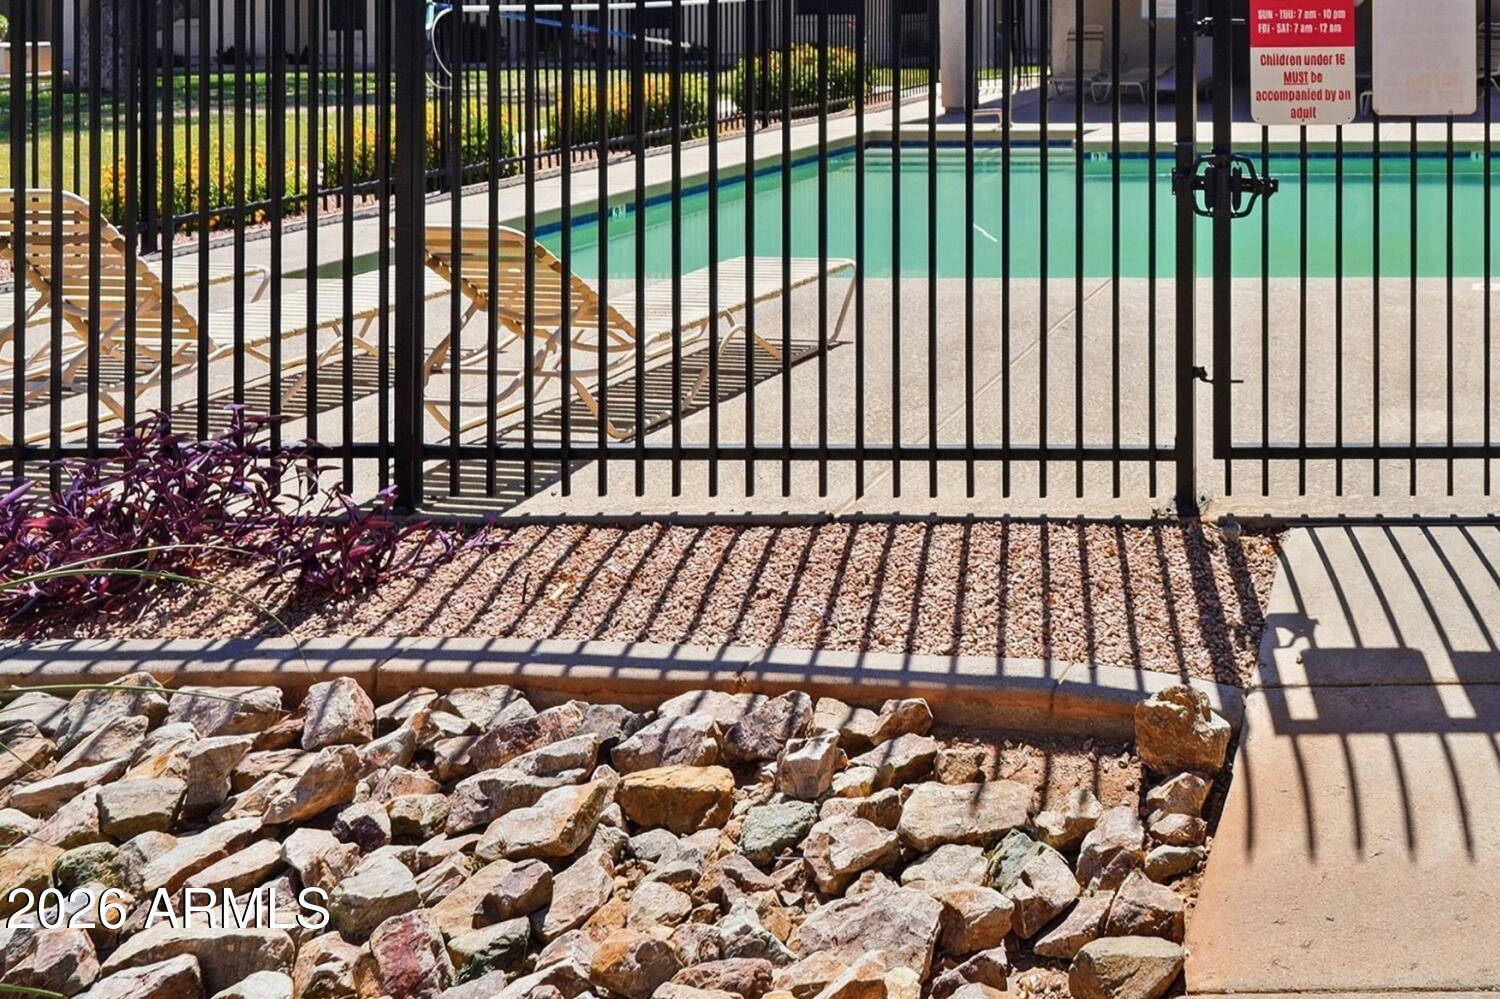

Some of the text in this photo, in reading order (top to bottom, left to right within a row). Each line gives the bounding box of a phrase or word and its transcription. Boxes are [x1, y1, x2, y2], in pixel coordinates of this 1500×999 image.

[1257, 9, 1273, 20] SUN
[1297, 9, 1303, 20] 7
[1304, 10, 1317, 19] am
[1323, 8, 1332, 20] 10
[1258, 23, 1270, 34] FRI
[1293, 23, 1299, 33] 7
[1300, 24, 1313, 33] am
[1319, 23, 1328, 33] 12
[1260, 54, 1345, 66] Children under 16
[1284, 71, 1323, 84] MUST be
[1256, 89, 1351, 102] accompanied by an
[1291, 107, 1317, 119] adult
